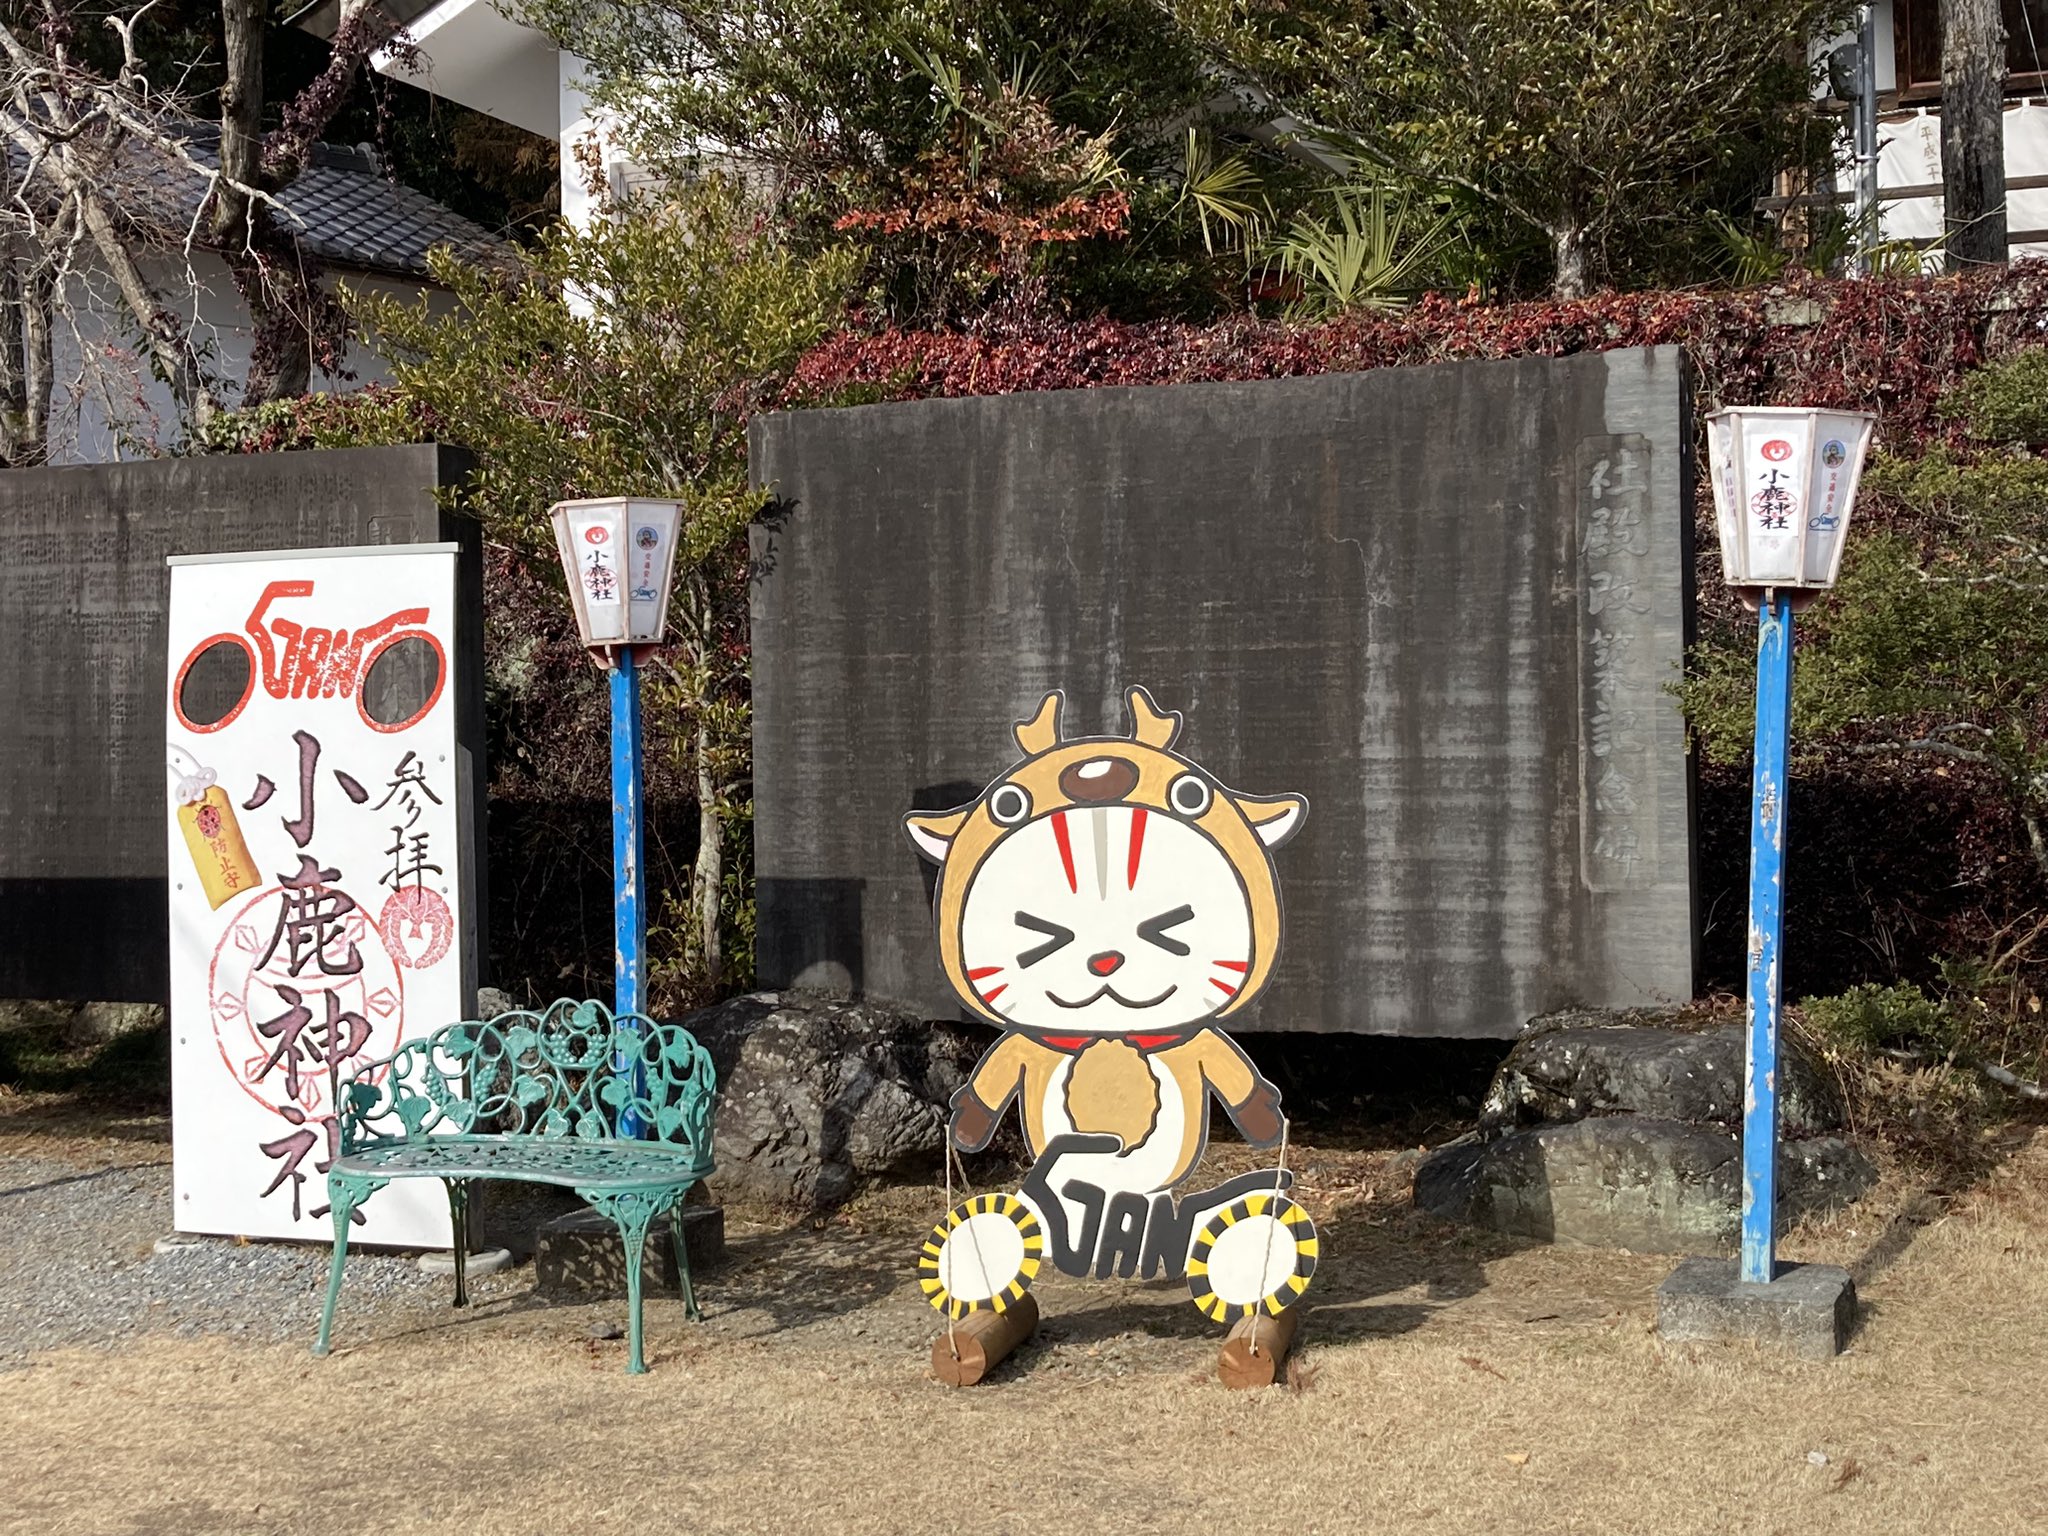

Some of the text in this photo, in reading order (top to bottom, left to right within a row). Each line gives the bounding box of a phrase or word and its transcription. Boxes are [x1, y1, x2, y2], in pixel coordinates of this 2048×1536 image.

[1758, 468, 1790, 530] 小鹿神社
[586, 550, 613, 600] 小鹿神社
[370, 751, 443, 906] 参拝
[242, 729, 373, 1226] 小鹿神社
